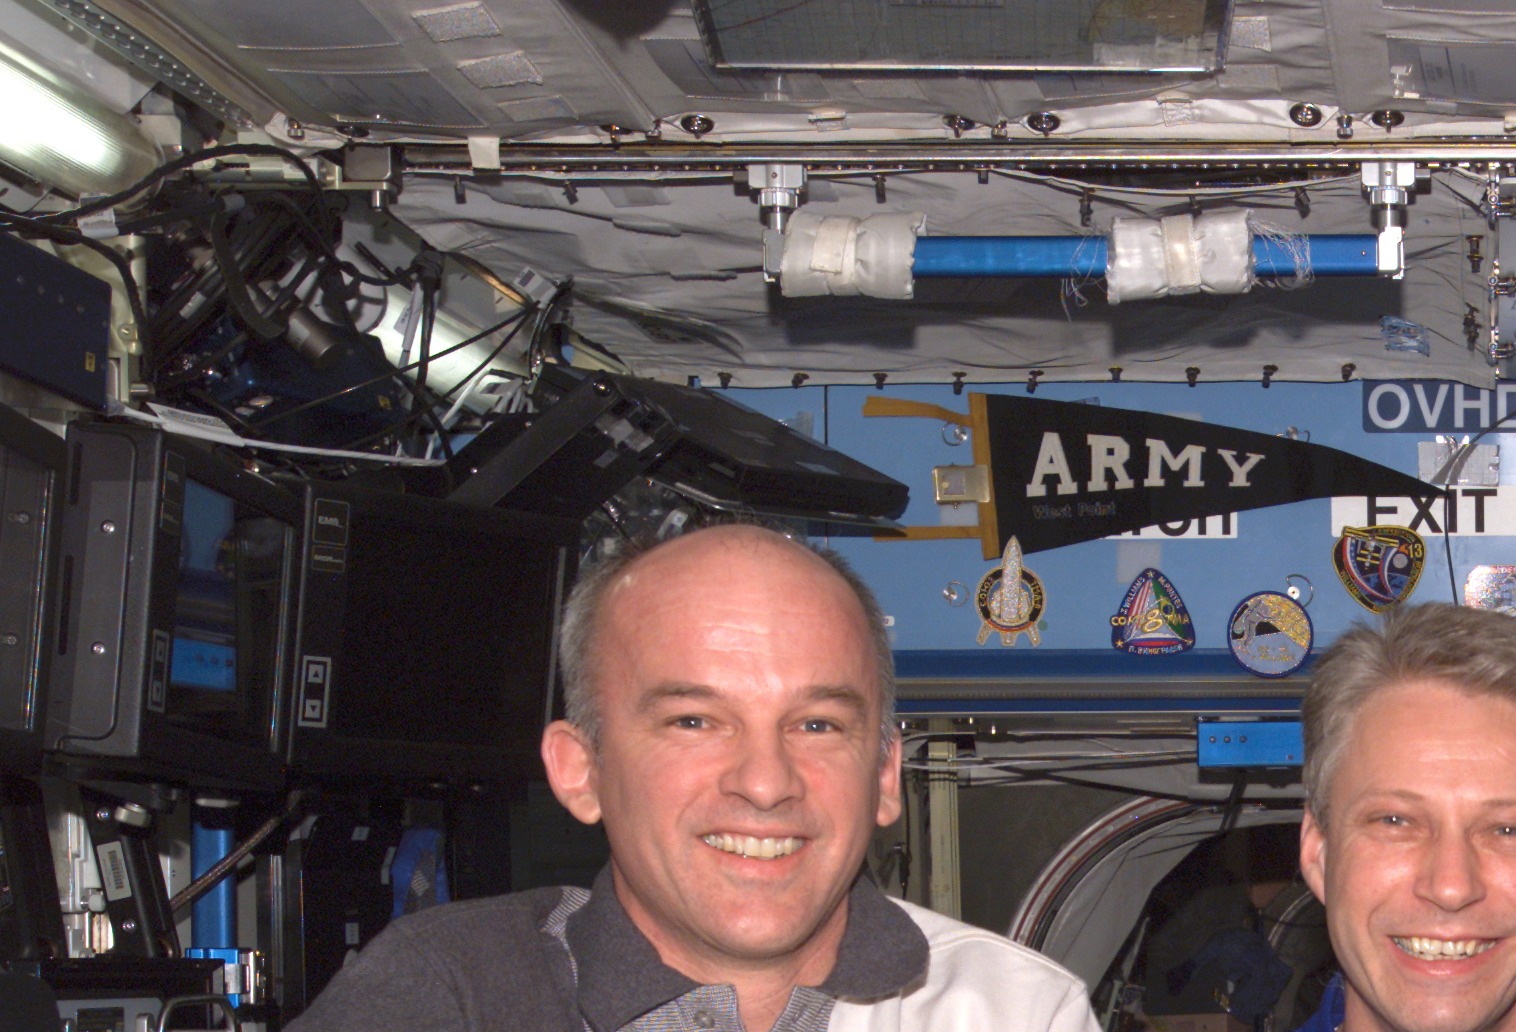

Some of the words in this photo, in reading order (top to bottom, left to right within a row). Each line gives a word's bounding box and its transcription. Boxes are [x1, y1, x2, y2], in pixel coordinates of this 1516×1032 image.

[1027, 432, 1265, 496] ARMY
[1077, 501, 1117, 517] Point
[1408, 543, 1423, 559] 13
